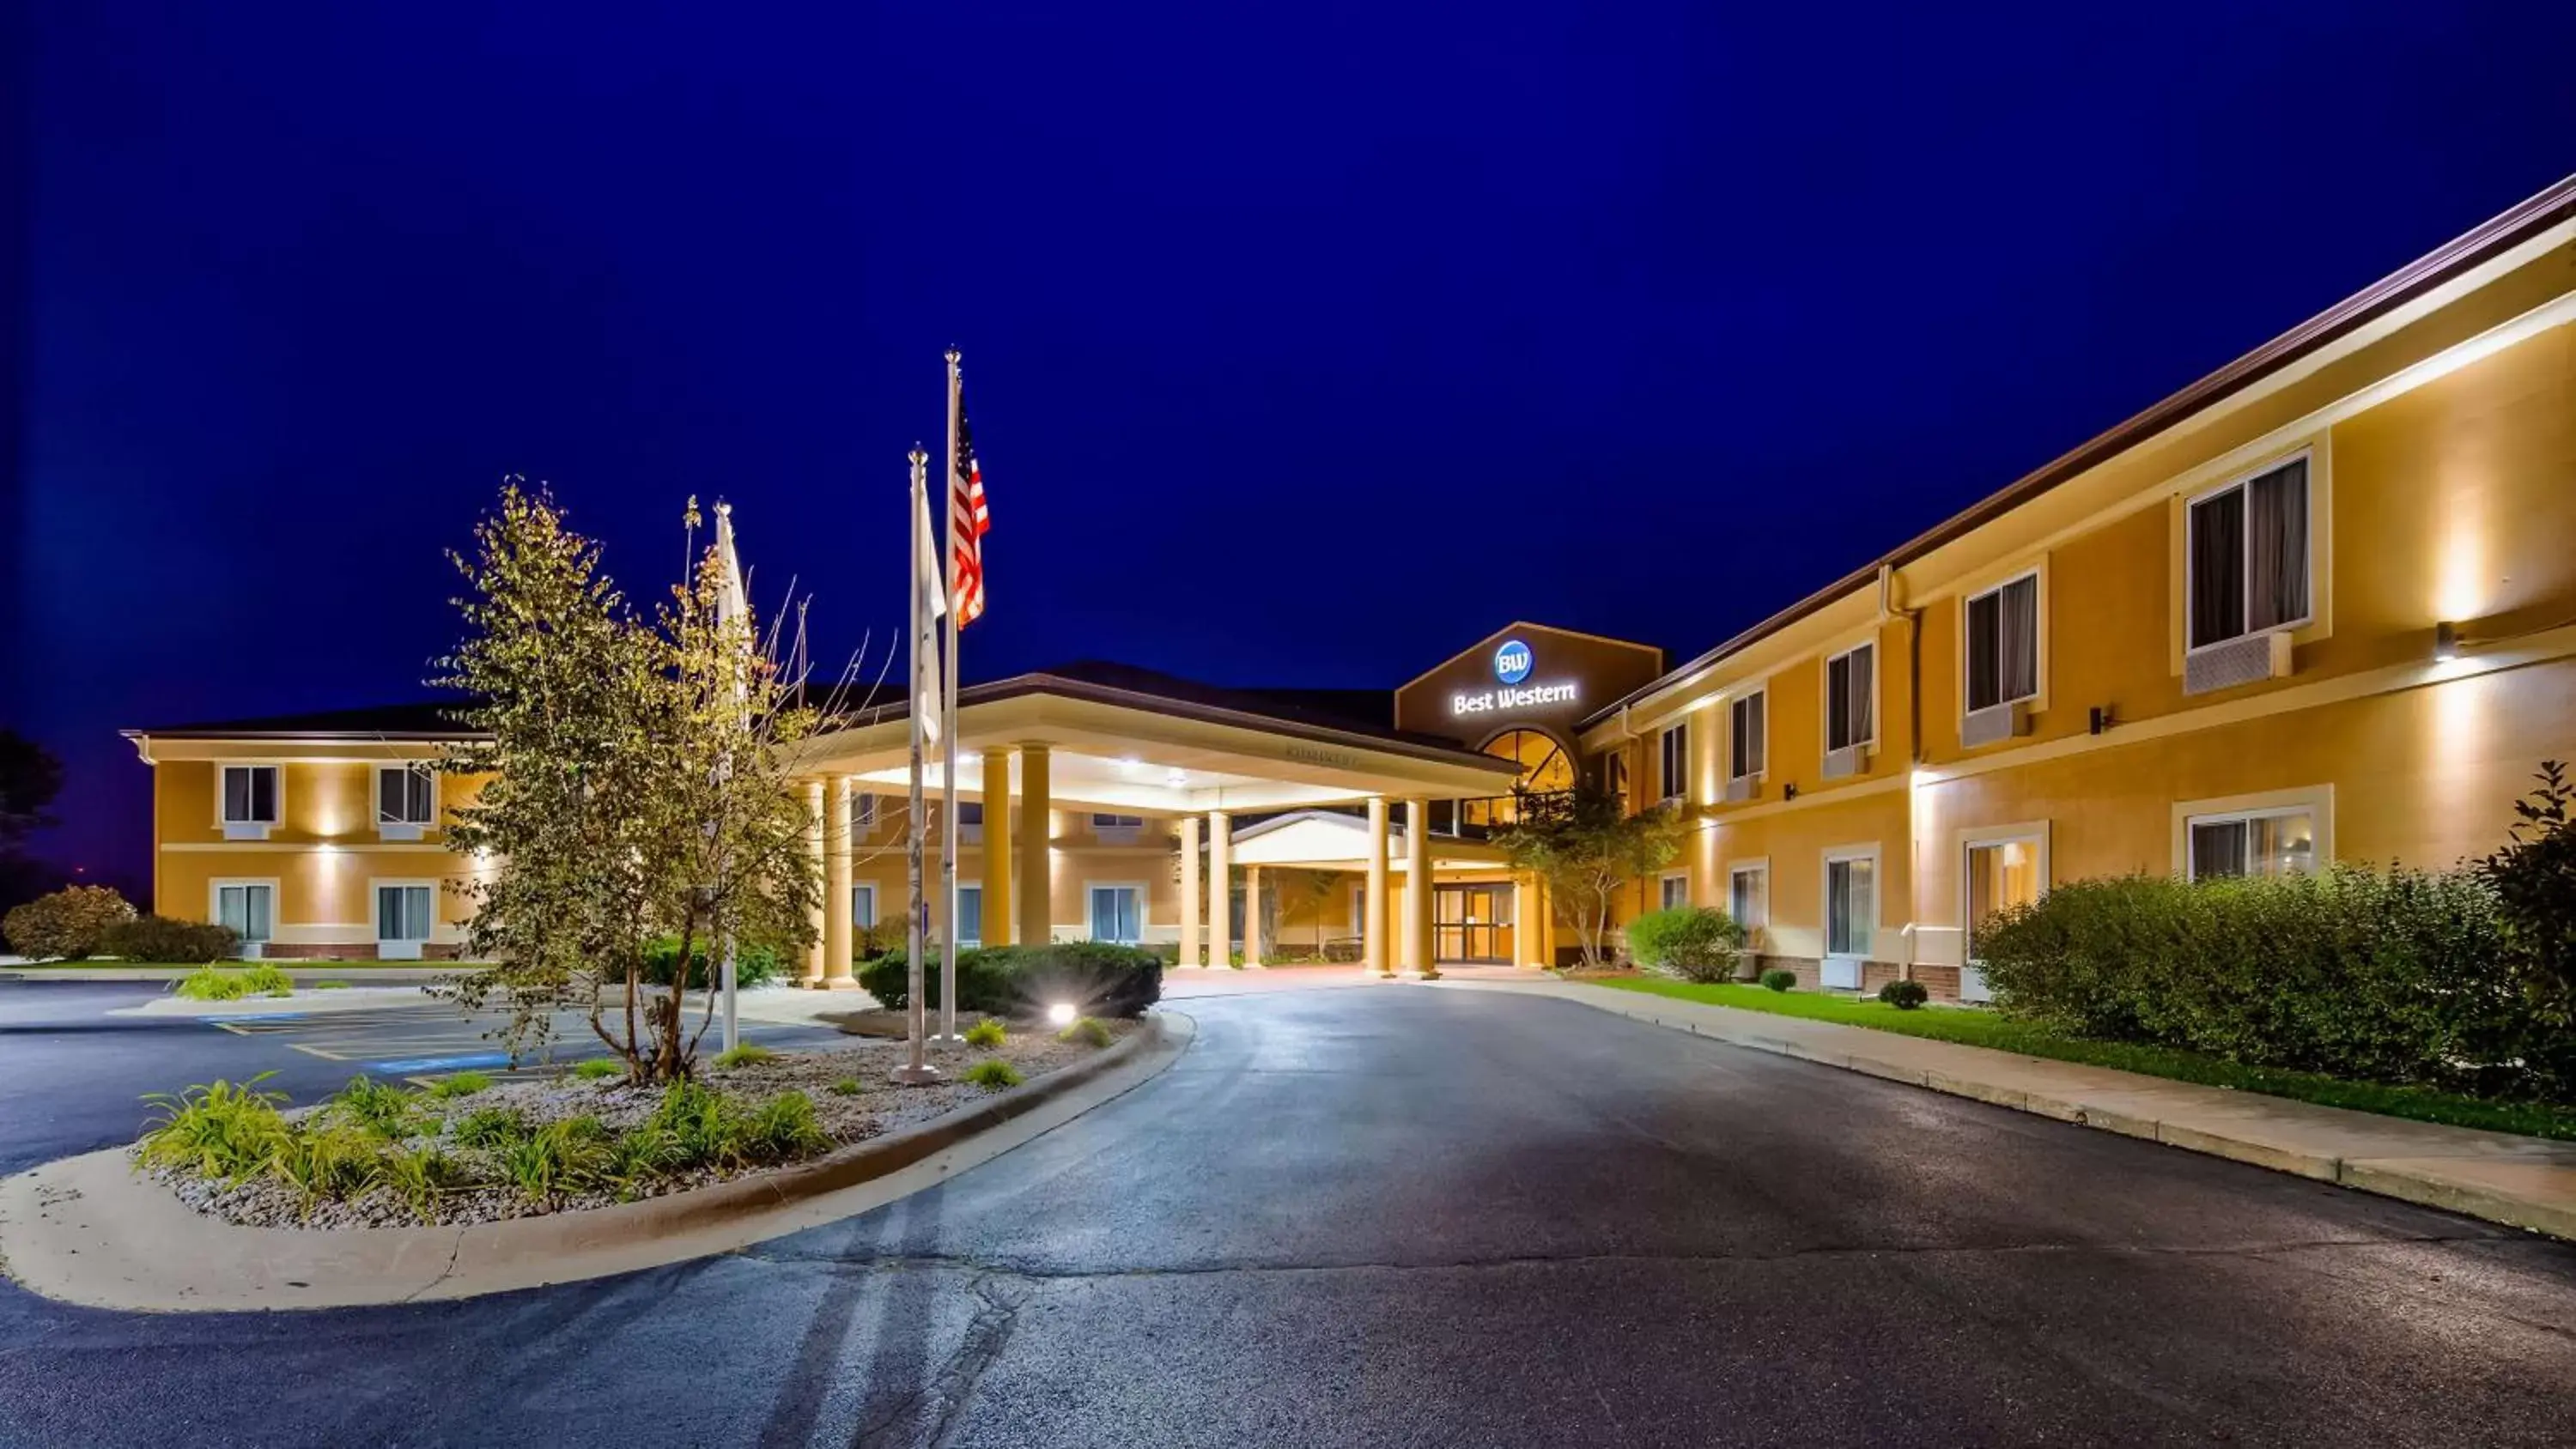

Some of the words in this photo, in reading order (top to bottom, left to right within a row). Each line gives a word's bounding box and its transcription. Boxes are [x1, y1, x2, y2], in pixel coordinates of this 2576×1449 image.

[1498, 652, 1528, 674] BW
[1454, 693, 1493, 714] Best
[1498, 684, 1576, 708] Western
